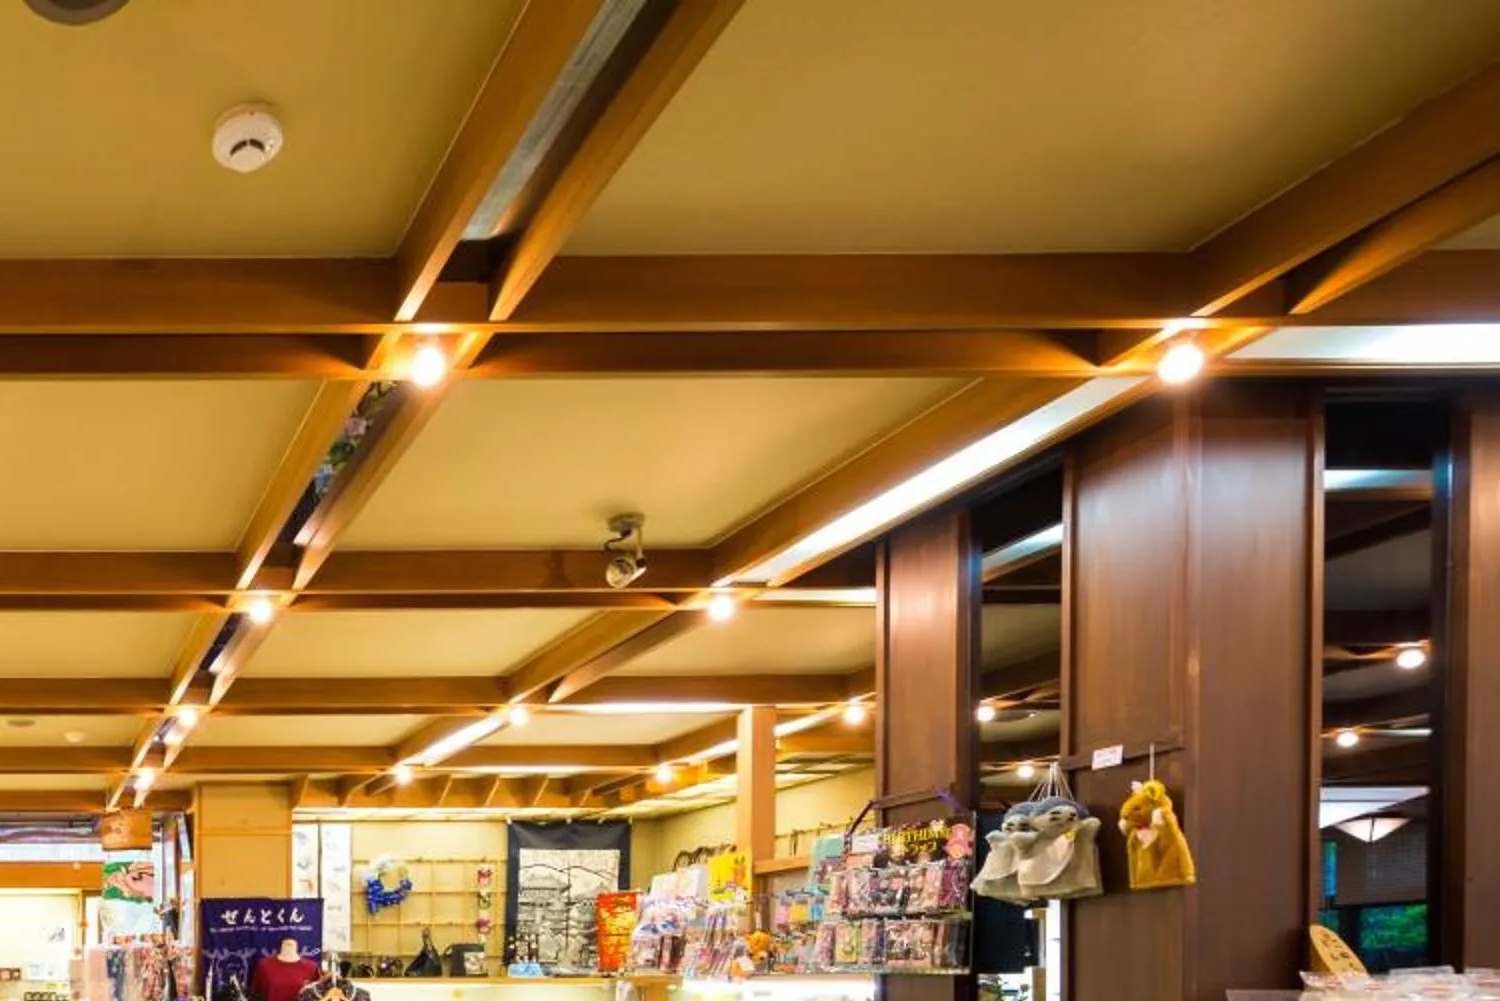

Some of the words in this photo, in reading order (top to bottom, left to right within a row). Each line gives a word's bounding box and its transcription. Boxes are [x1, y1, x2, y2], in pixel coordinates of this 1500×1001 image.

[221, 907, 305, 924] せんとくん
